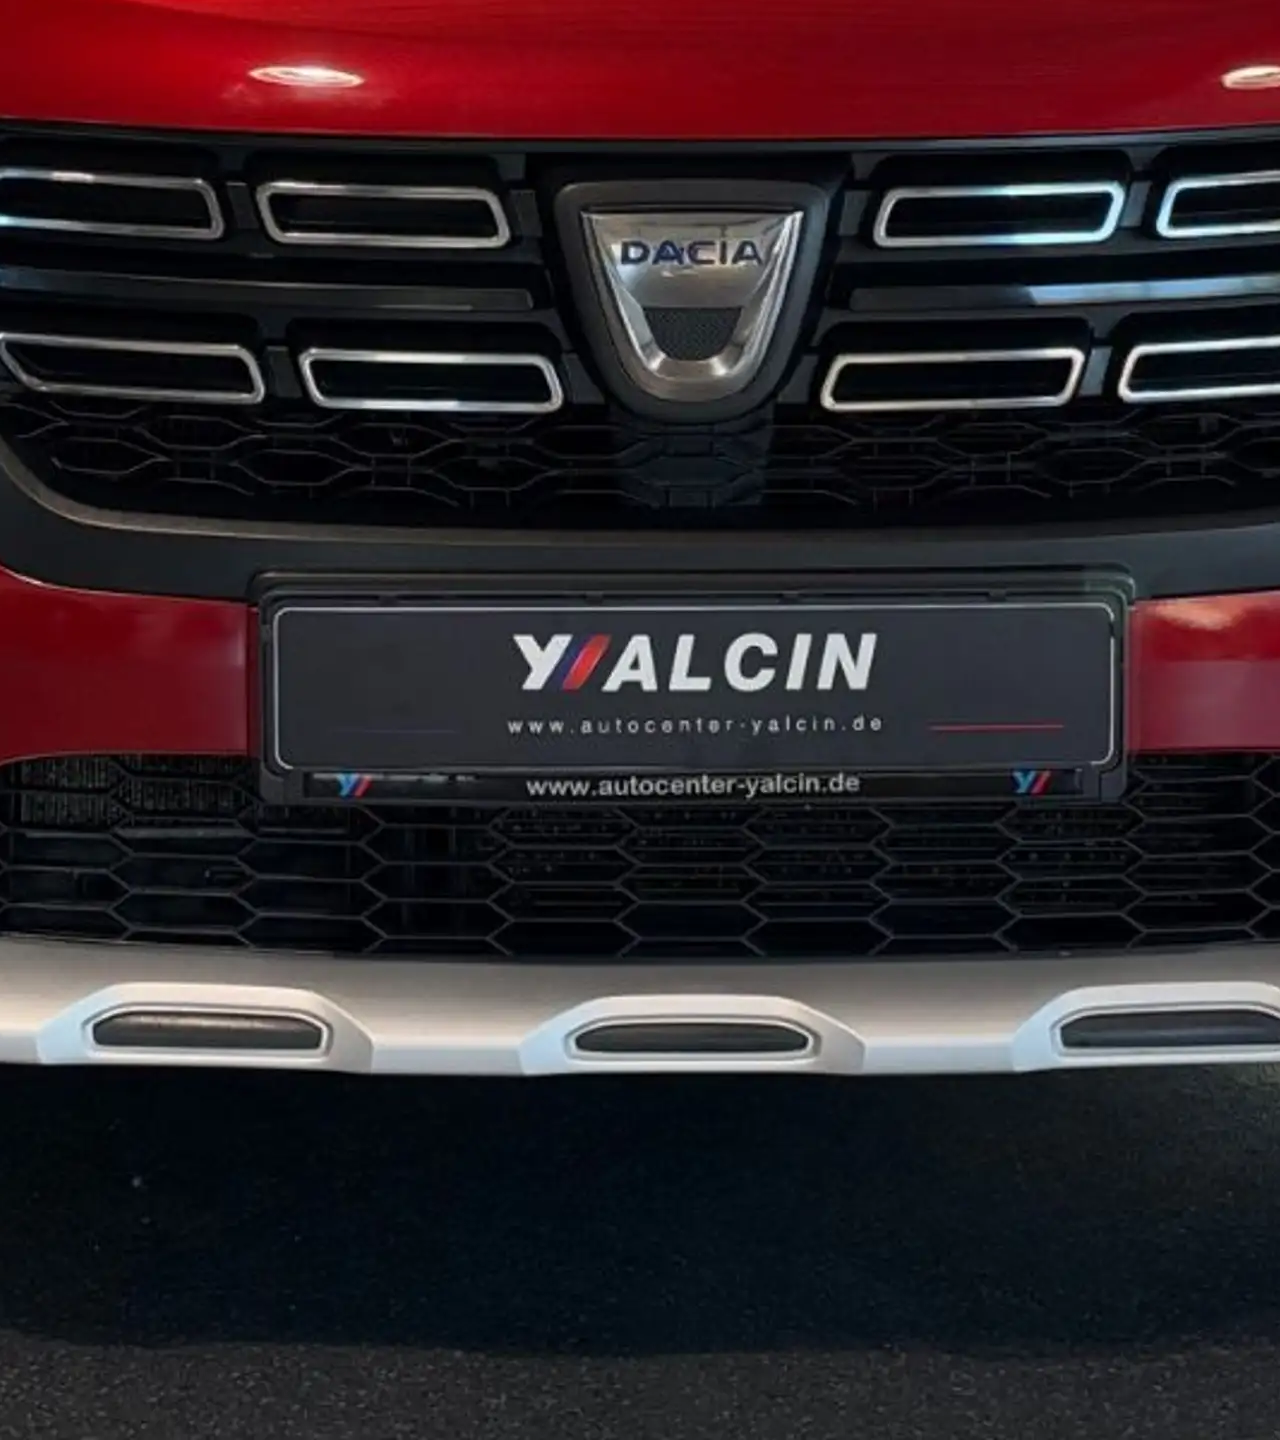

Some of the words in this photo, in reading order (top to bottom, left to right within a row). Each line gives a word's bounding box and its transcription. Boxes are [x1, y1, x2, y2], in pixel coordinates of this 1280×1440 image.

[620, 239, 764, 266] DACIA
[507, 713, 883, 735] www.autocenter-yalcin.de
[526, 773, 861, 799] www.autocenter-yalcin.de
